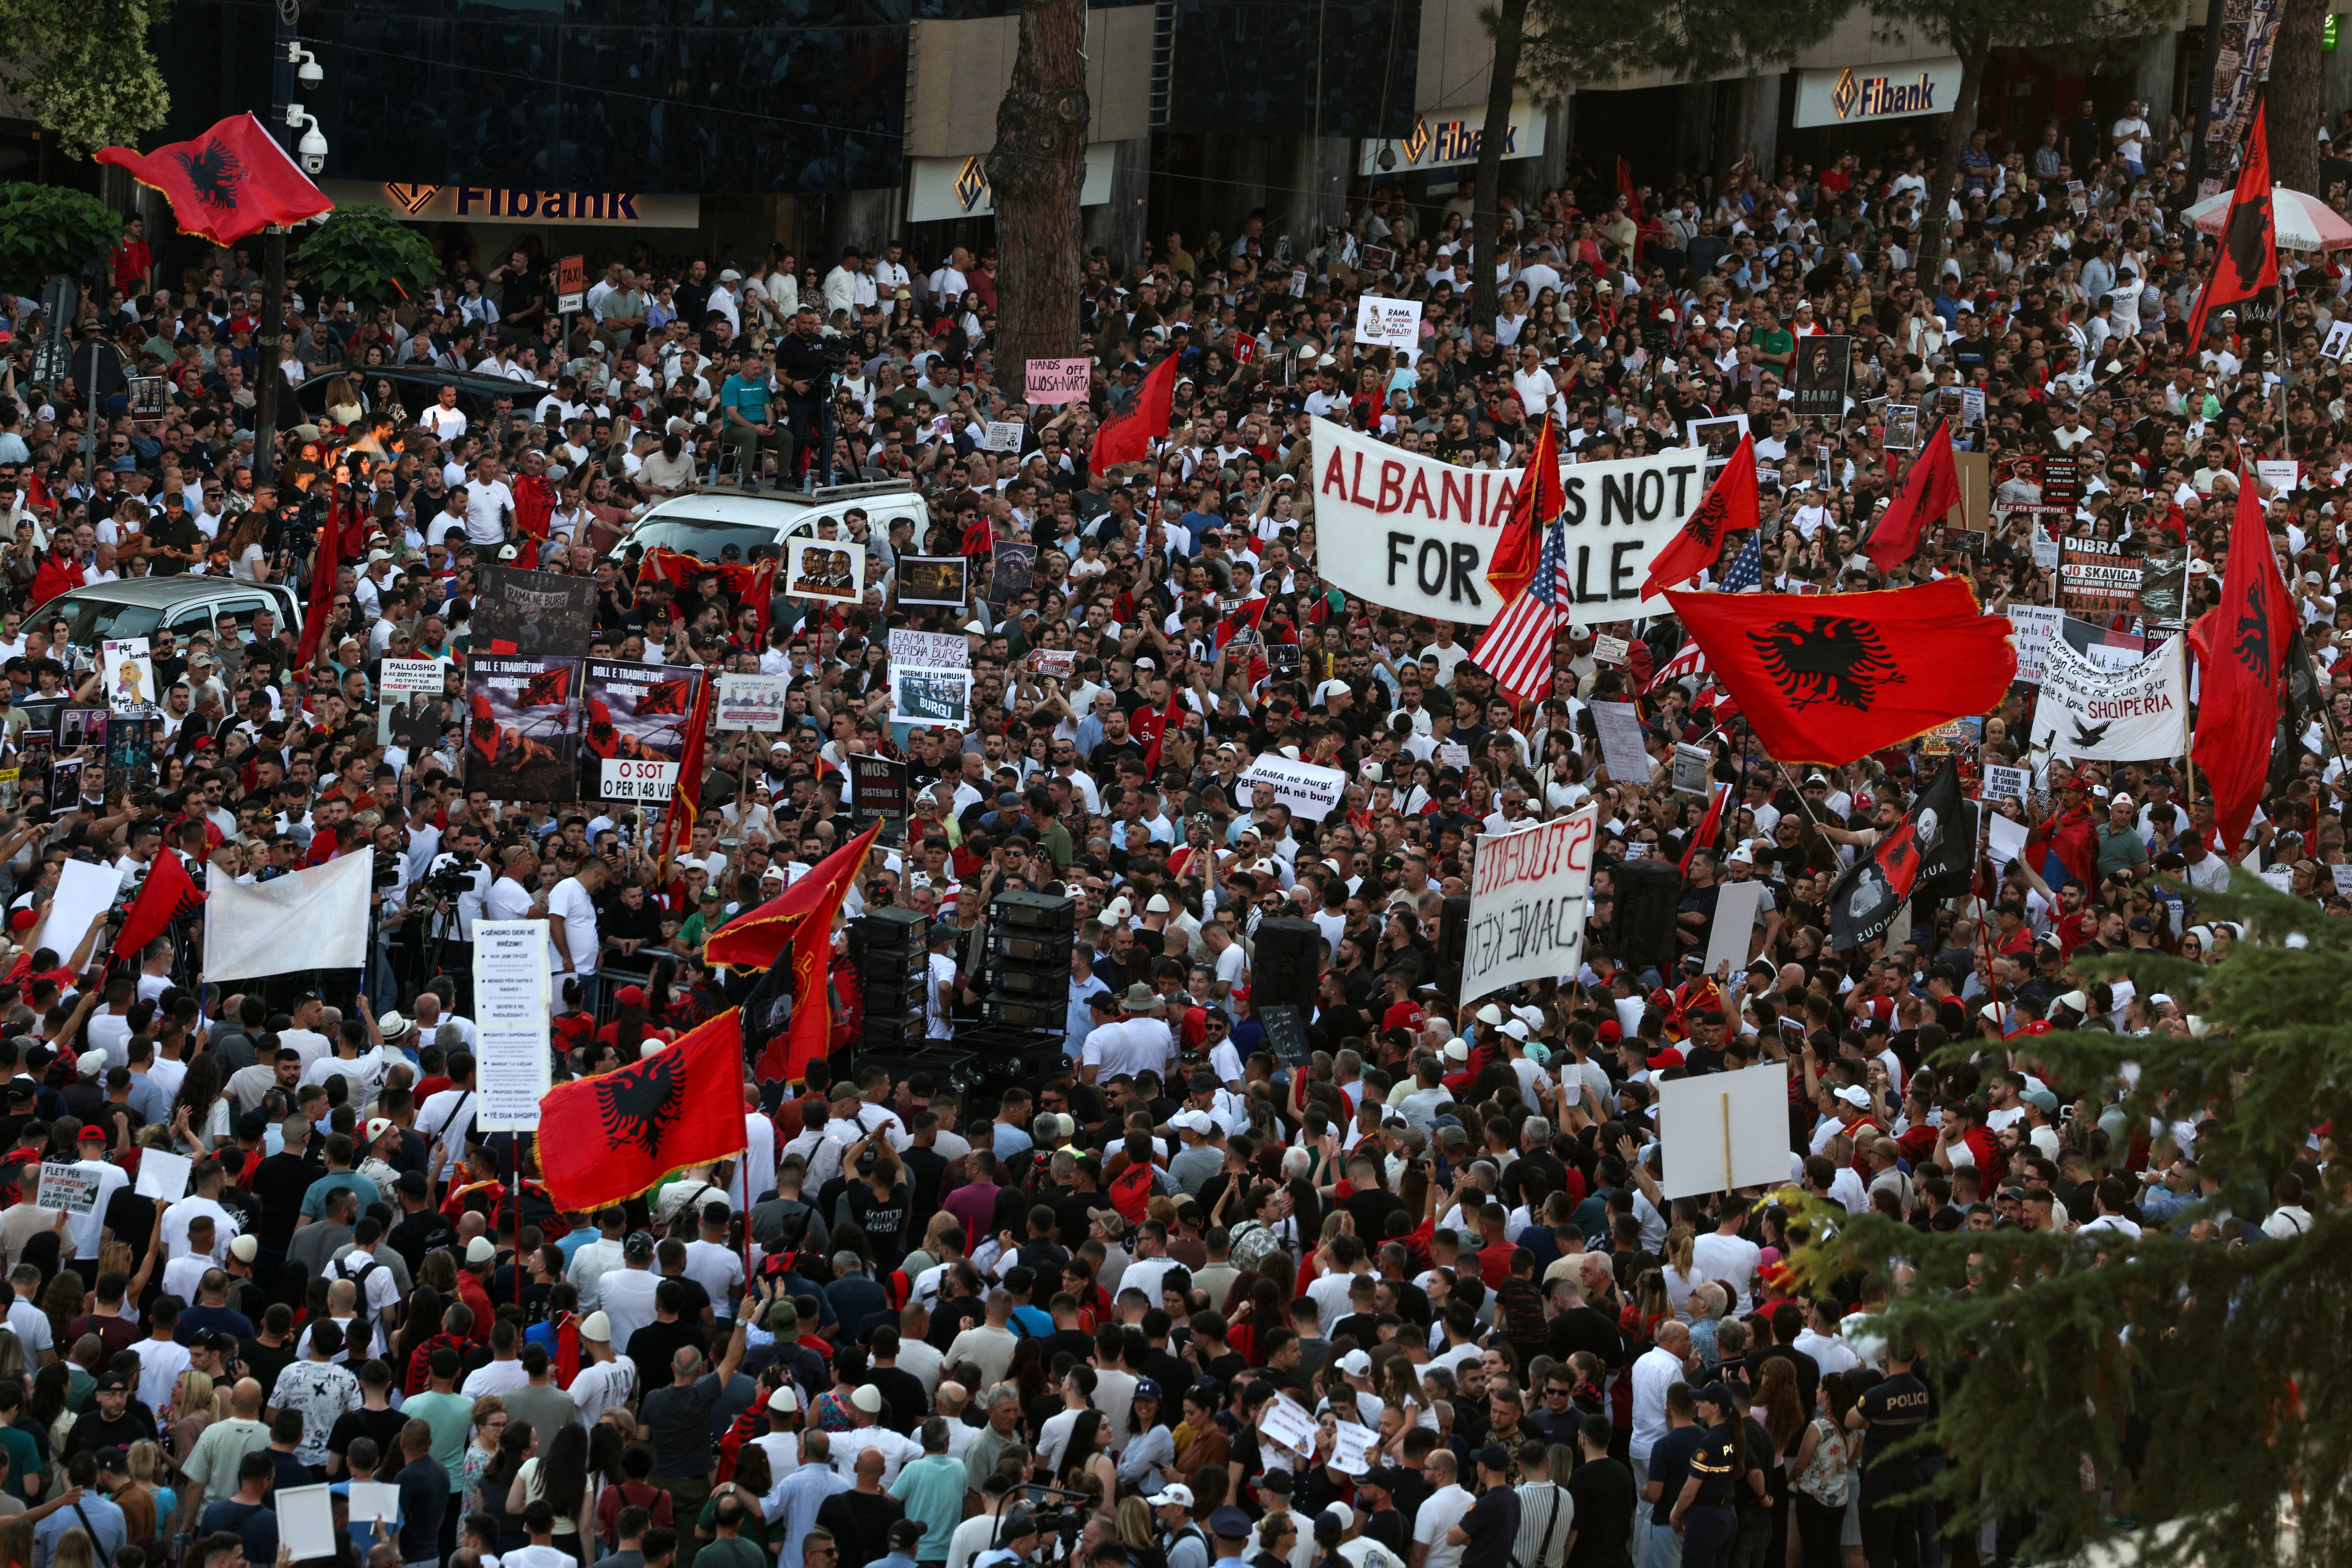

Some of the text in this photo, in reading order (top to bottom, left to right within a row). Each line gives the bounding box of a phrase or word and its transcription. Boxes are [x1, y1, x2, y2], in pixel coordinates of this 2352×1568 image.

[1858, 72, 1935, 117] Fibank
[1431, 120, 1517, 163] Fibak
[562, 266, 581, 285] TAXI
[2114, 293, 2133, 302] UGO
[1388, 309, 1412, 318] RAMA,
[1031, 360, 1060, 370] HANDS
[1066, 365, 1085, 375] OFF
[1801, 390, 1837, 402] RAMA
[1322, 445, 1698, 528] ALBANIA S NOT
[2029, 505, 2067, 513] SHQIPËRINË!
[2064, 536, 2121, 556] DIBRA
[2063, 550, 2144, 570] PROTESTON!
[1388, 531, 1645, 605] FOR LE
[2065, 565, 2137, 581] JO SKAVICA
[2064, 576, 2083, 586] LËRENI
[508, 588, 565, 605] RAMA NË BURG
[813, 585, 834, 595] SHIT
[835, 588, 855, 597] TRIO
[2080, 587, 2108, 596] MBYTET
[2110, 590, 2135, 599] DIBRA!
[2064, 595, 2110, 611] RAMA
[2017, 607, 2057, 621] need money
[2022, 623, 2038, 638] go to
[894, 631, 965, 649] RAMA BURG
[2020, 638, 2045, 655] to give
[119, 643, 133, 655] për
[892, 644, 964, 661] BERISHA BURG
[390, 663, 437, 671] PALLOSHO
[475, 660, 545, 674] BOLL E TRADHËTOVE
[2090, 652, 2106, 668] Nuk
[593, 665, 665, 683] BOLL E TRADHËTOVE
[900, 669, 922, 678] NISEMI
[1041, 664, 1068, 675] SISTEMIN!!
[488, 676, 531, 690] SHQIPËRINE
[606, 681, 650, 697] SHQIPËRINE
[2050, 670, 2167, 701] çdo e çdo gur
[118, 696, 131, 708] për
[920, 697, 952, 719] BURGU
[2088, 693, 2173, 720] SHQIPËRIA
[620, 762, 664, 780] O SOT
[860, 762, 890, 778] MOS
[1993, 767, 2021, 780] MJERIMI
[1252, 768, 1333, 791] RAMA në burg!
[1991, 775, 2021, 788] QË SHKROI
[604, 780, 655, 798] O PER 148
[861, 787, 898, 798] SISTEMIN E
[1987, 790, 1998, 799] SOT
[1993, 783, 2018, 795] MIGJENI
[1293, 788, 1335, 806] në burg!
[861, 807, 900, 818] SHËNDETËSOR!
[2169, 902, 2185, 911] das
[45, 1166, 81, 1179] FLET PËR
[43, 1176, 87, 1189] INFLUENCERAT
[52, 1192, 72, 1202] MBYLL
[865, 1209, 902, 1220] SCOTCH
[866, 1223, 898, 1233] &SODA
[1887, 1391, 1928, 1411] POLICI
[1723, 1443, 1734, 1457] PO
